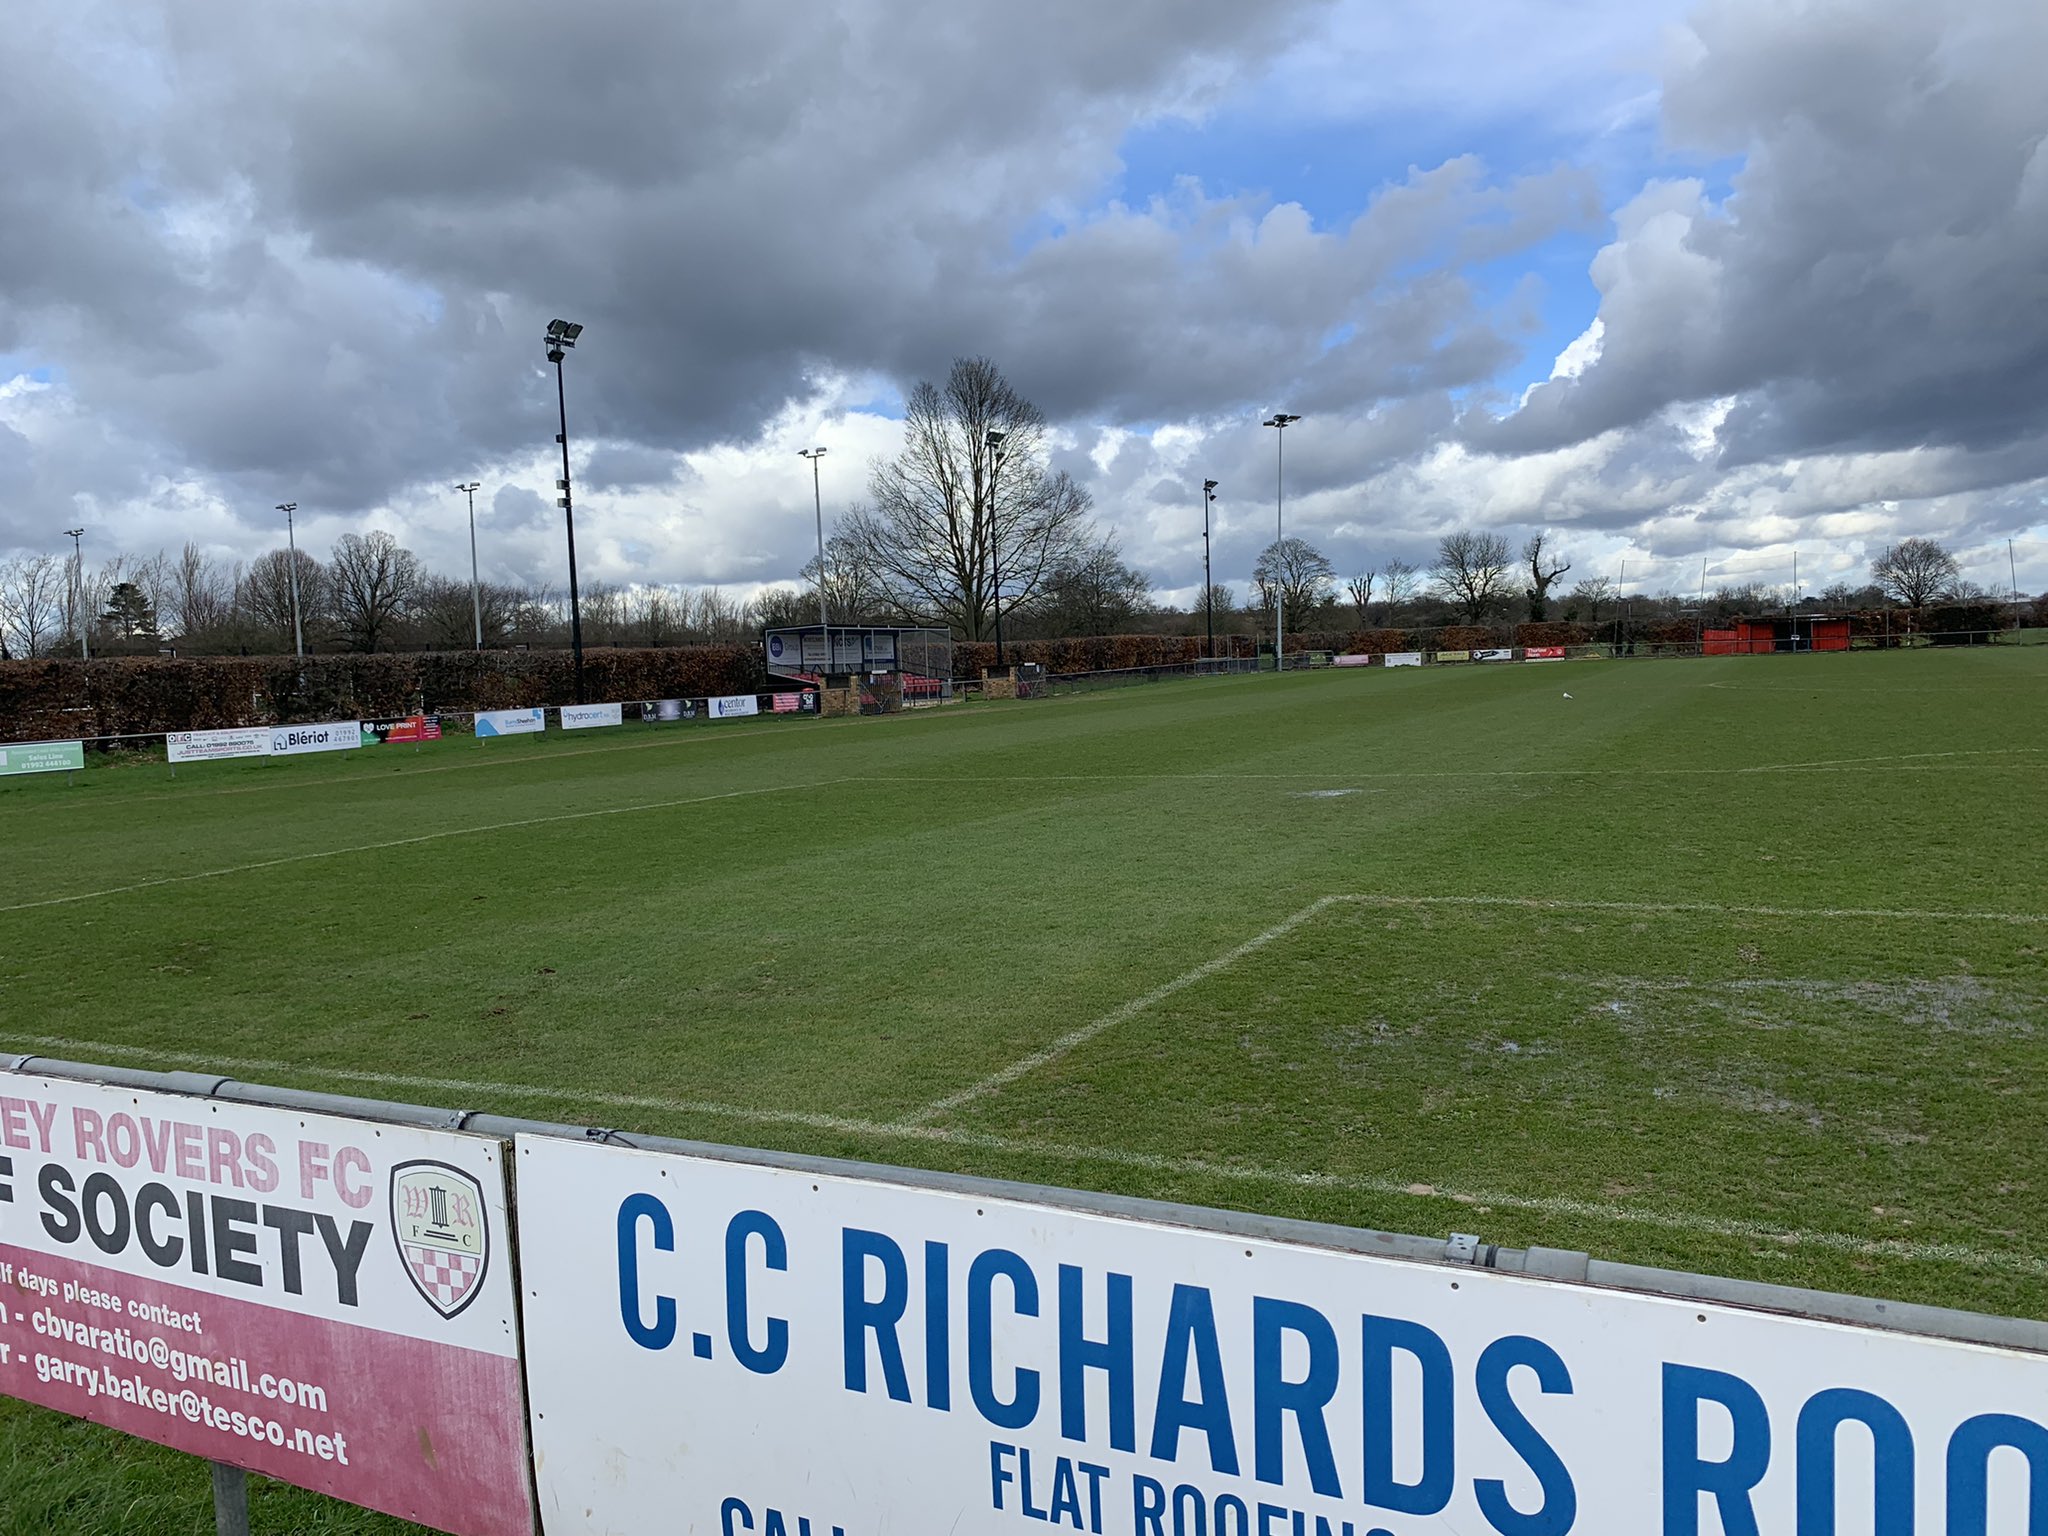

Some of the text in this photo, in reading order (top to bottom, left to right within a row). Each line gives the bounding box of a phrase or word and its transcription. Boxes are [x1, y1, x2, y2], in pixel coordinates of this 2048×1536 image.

[288, 731, 330, 746] Blériot
[376, 721, 417, 731] LOVE PRINT
[0, 1095, 57, 1154] EY
[72, 1107, 280, 1194] ROVERS
[298, 1139, 374, 1209] FC
[37, 1163, 375, 1308] SOCIETY
[412, 1225, 472, 1247] F C
[0, 1262, 203, 1335] lf days please contact
[15, 1312, 25, 1322] -
[32, 1307, 328, 1413] cbvaratio@gmail.com
[18, 1353, 27, 1363] -
[35, 1352, 350, 1467] garry.baker@tesco.net
[616, 1192, 789, 1375] C.C
[841, 1226, 1577, 1536] RICHARDS
[989, 1440, 1110, 1536] FLAT
